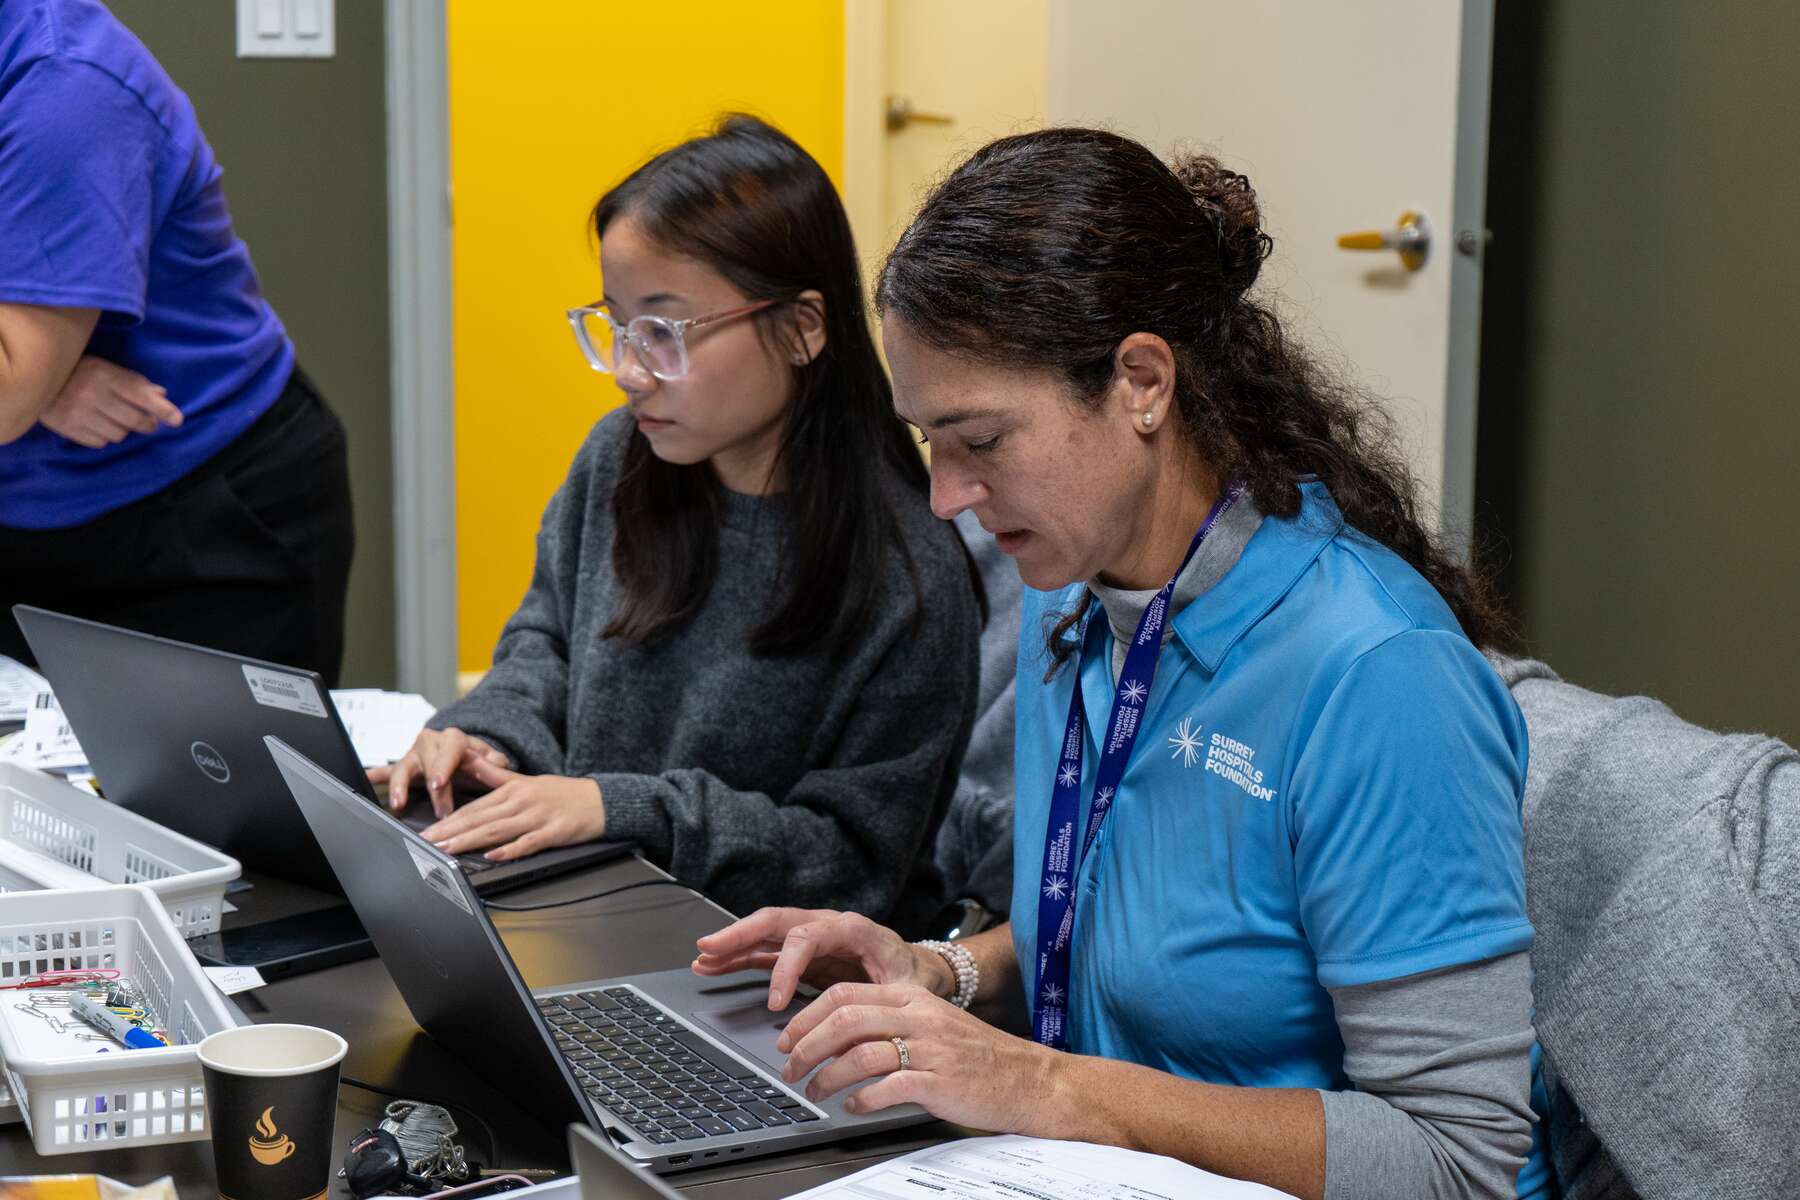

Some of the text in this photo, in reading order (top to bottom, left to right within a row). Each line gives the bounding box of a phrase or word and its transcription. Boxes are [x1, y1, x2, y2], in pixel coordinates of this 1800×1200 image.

[1155, 599, 1165, 631] SURREY
[1108, 705, 1126, 754] FOUNDATION
[1116, 706, 1132, 749] HOSPITALS
[1126, 708, 1139, 739] SURREY
[1208, 745, 1264, 783] HOSPITALS
[1211, 733, 1255, 761] SURREY
[1048, 839, 1057, 871] SURREY
[1055, 828, 1066, 872] HOSPITALS
[1061, 822, 1072, 872] FOUNDATION
